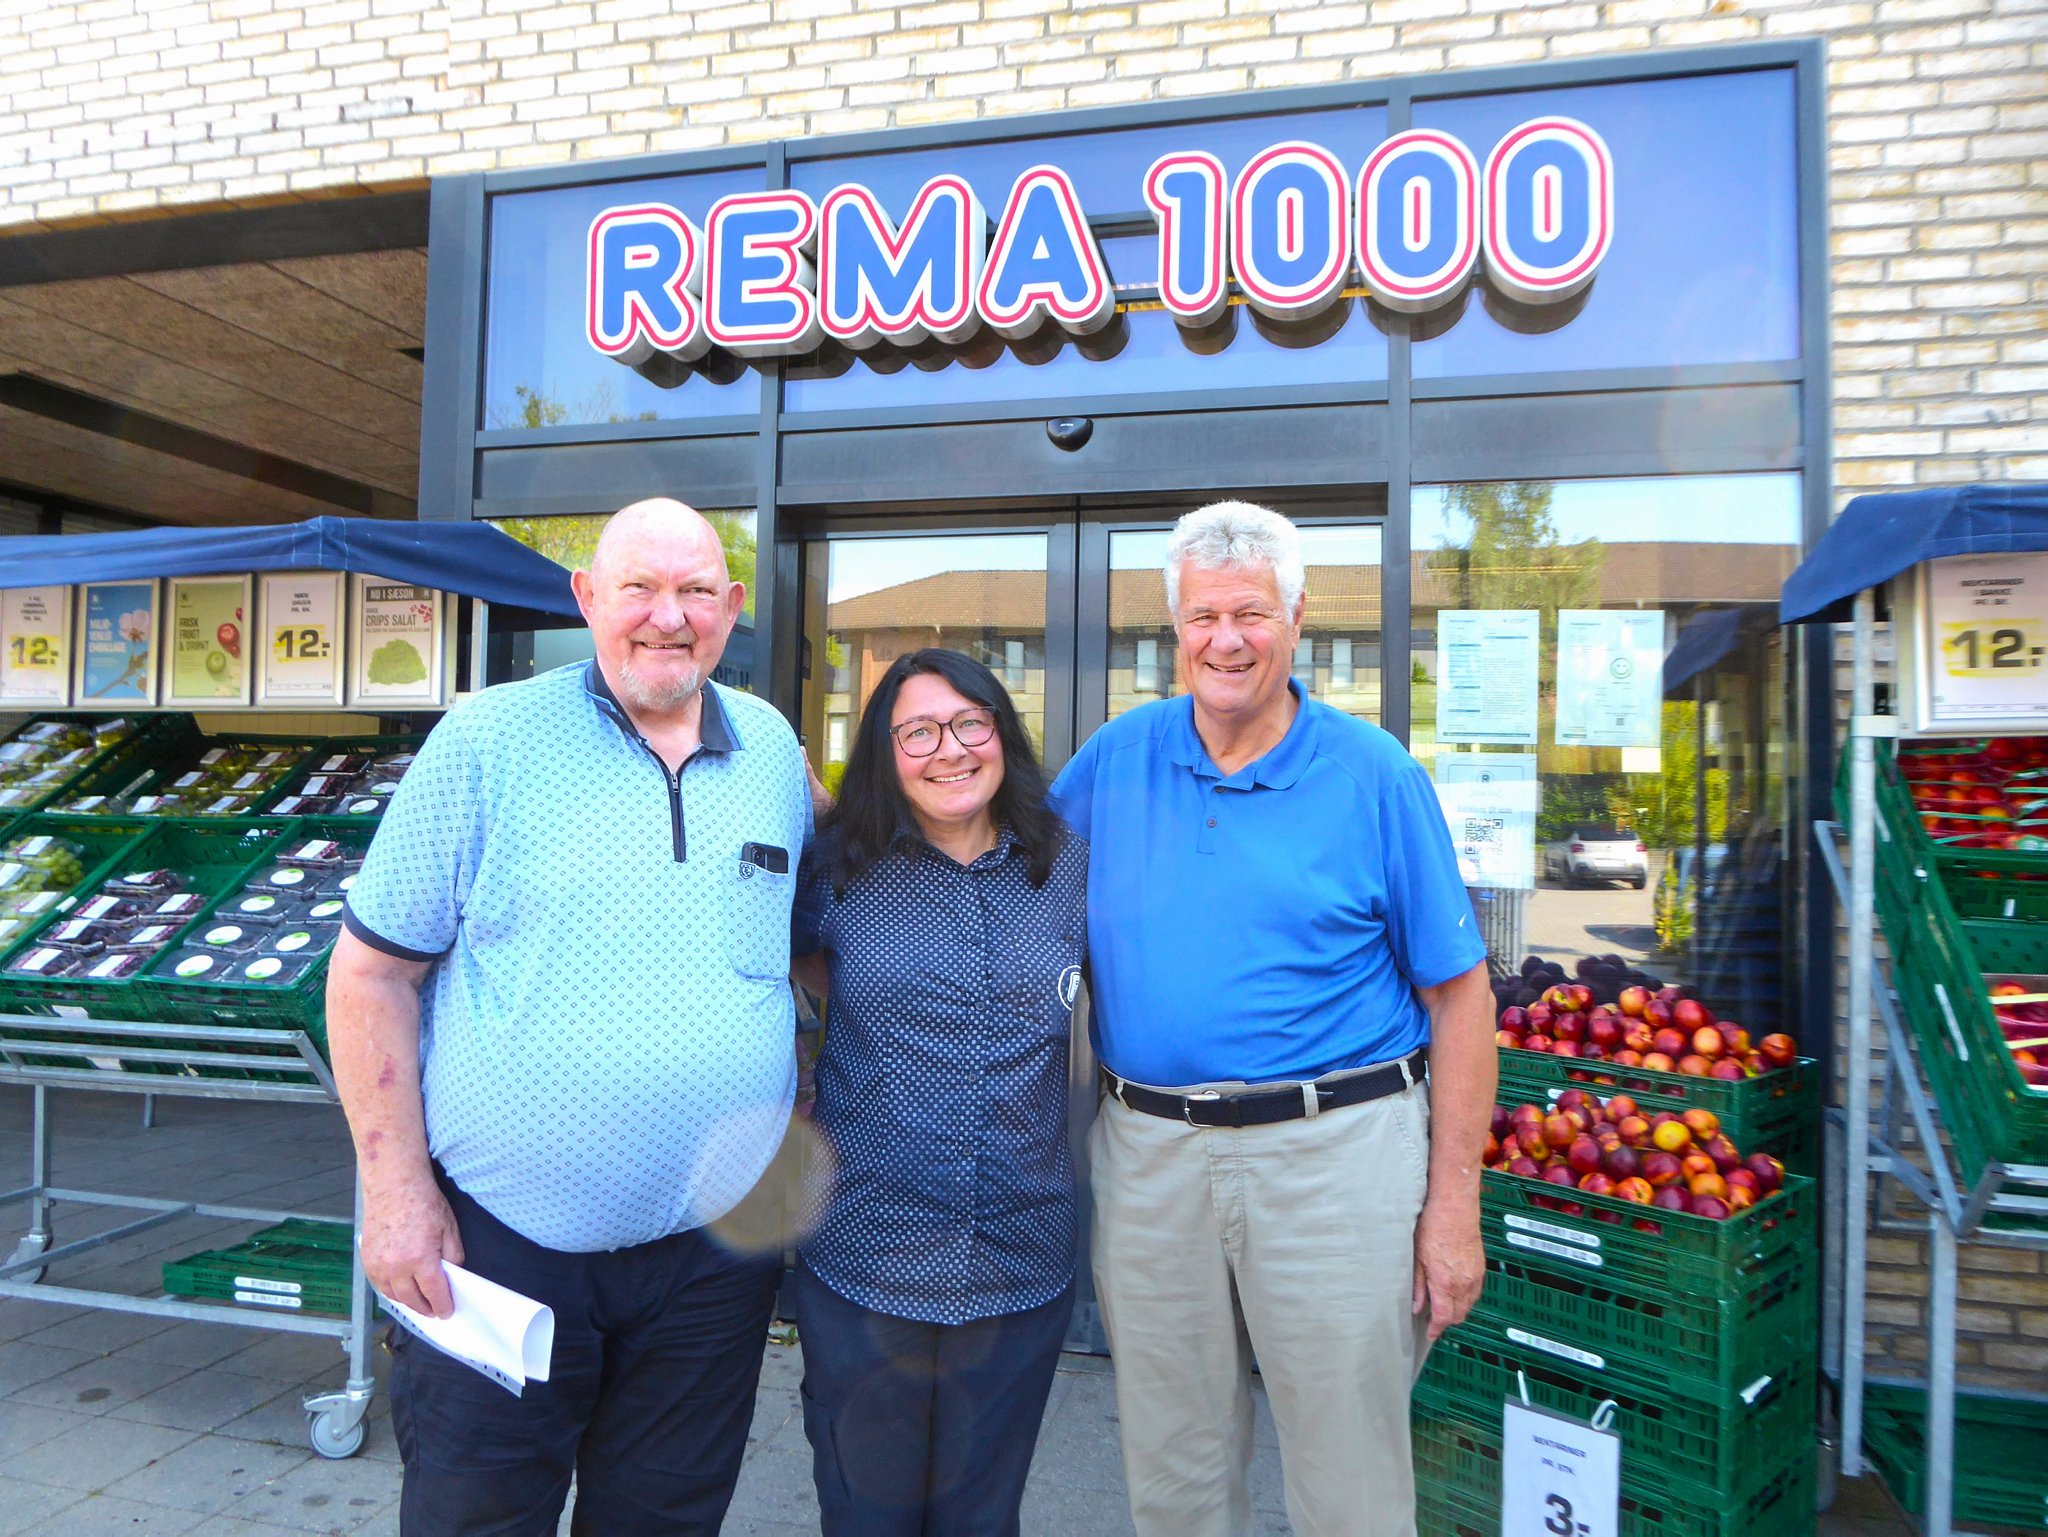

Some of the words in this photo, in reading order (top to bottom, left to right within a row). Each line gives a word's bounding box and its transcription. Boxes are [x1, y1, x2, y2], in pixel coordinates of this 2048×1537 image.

[585, 163, 1113, 357] REMA
[1142, 116, 1614, 317] 1000
[387, 588, 414, 600] SÆSON
[392, 614, 416, 627] SALAT
